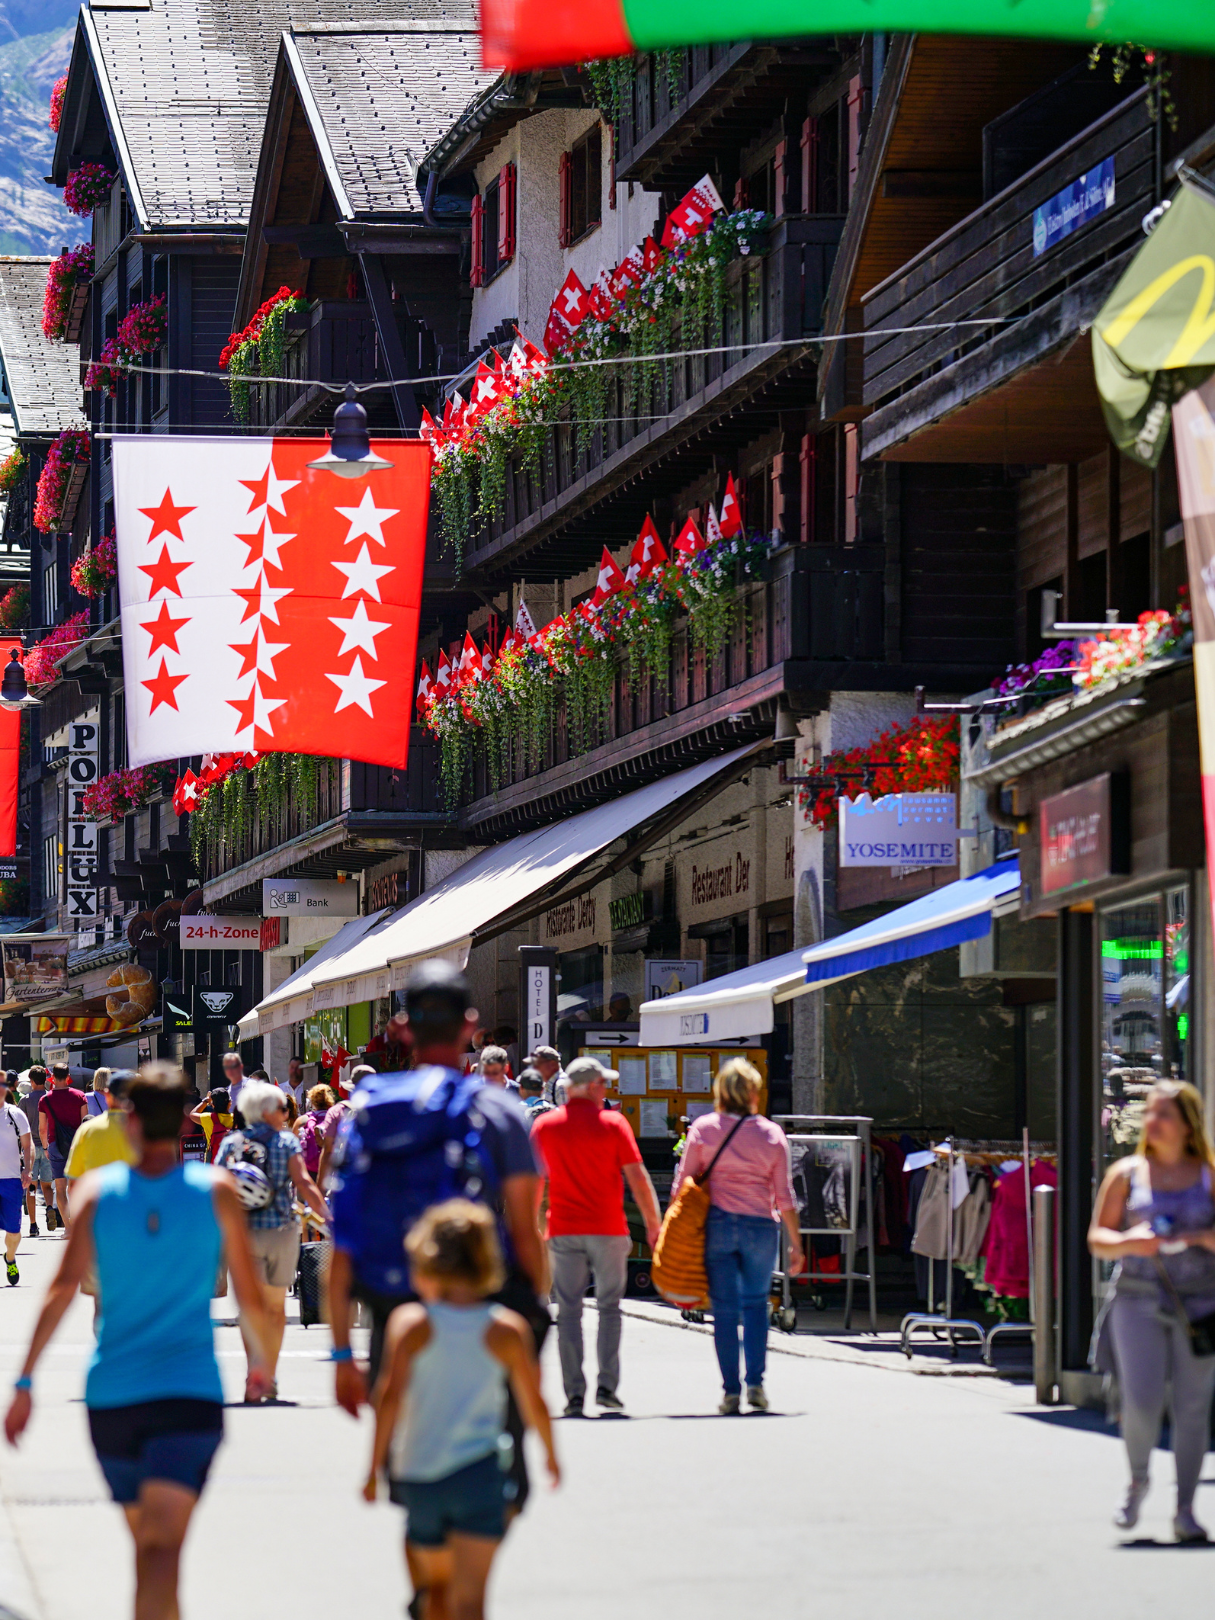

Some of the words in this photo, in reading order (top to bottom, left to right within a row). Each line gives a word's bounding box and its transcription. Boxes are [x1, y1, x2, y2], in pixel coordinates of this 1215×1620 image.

[847, 843, 954, 858] YOSEMITE
[691, 858, 733, 906] Restaurant
[306, 898, 328, 908] Bank
[577, 889, 597, 935] Derby
[186, 926, 259, 939] 24-h-Zone
[534, 970, 543, 1016] HOTEL
